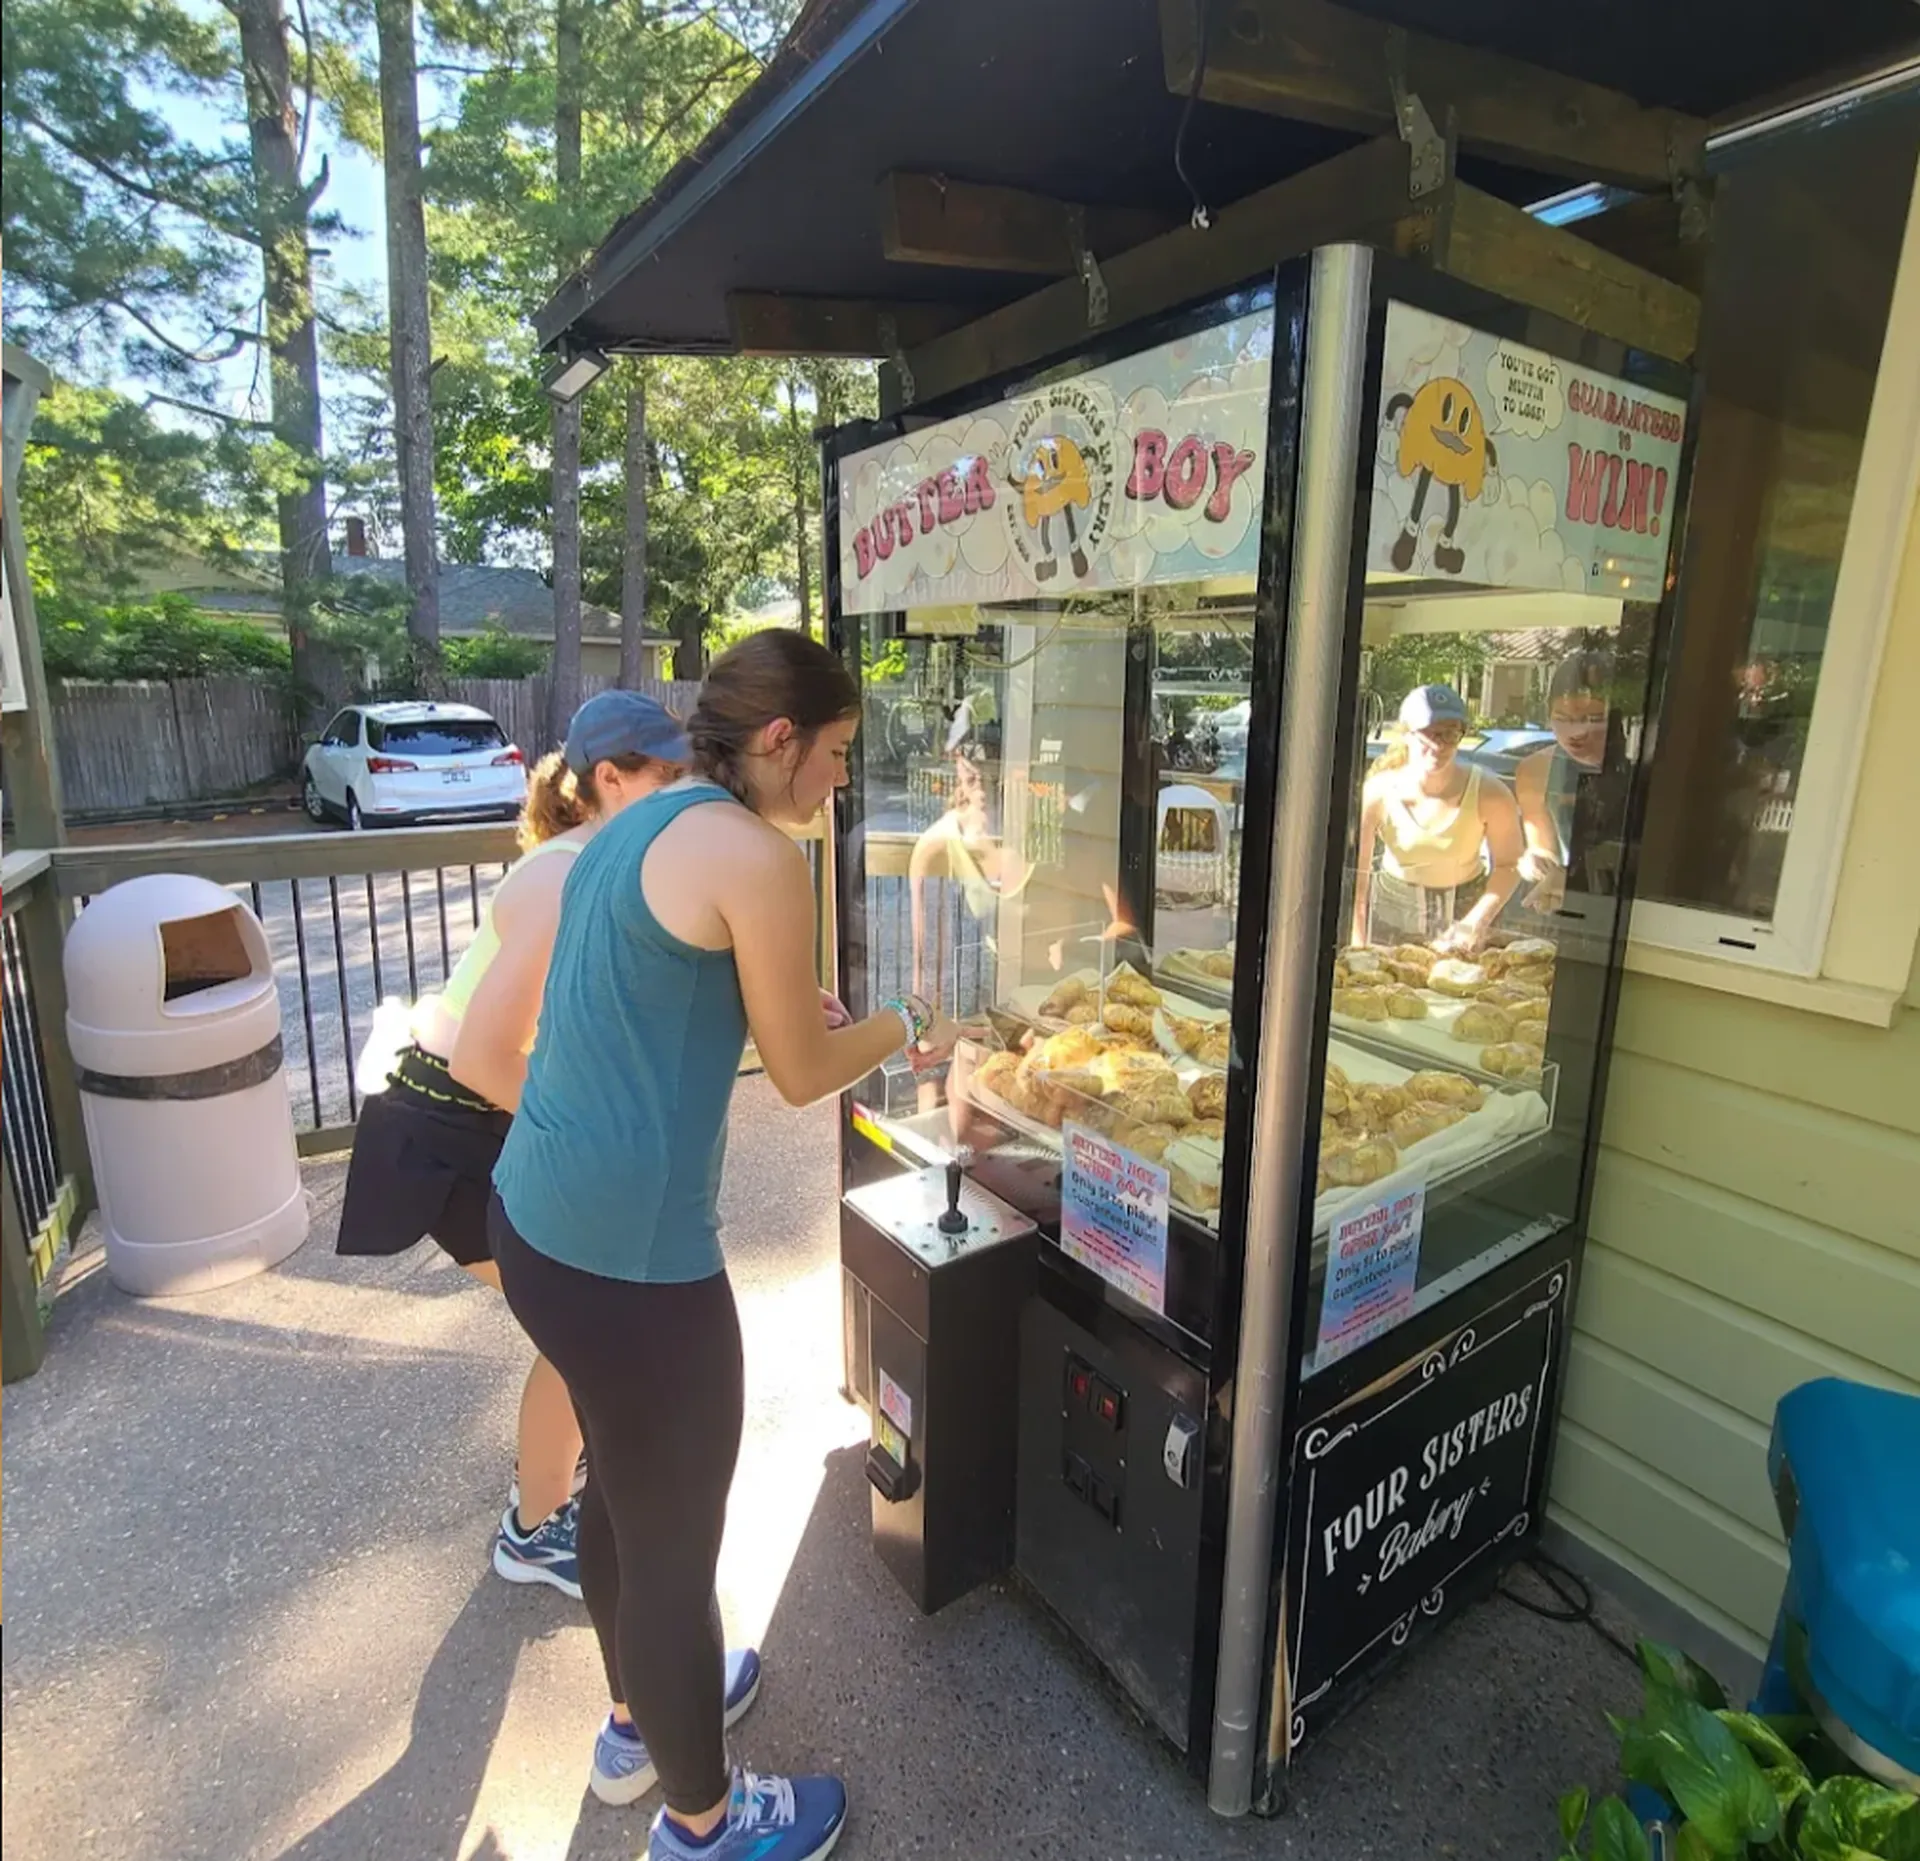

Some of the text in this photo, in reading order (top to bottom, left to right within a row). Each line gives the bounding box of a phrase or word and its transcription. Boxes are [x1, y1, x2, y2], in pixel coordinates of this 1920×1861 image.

[1500, 352, 1556, 385] YOU'VE GOT
[1503, 396, 1546, 423] TO LOSE!
[1567, 378, 1682, 443] GUARANTEED
[853, 427, 1256, 580] BUTTER BOY
[1013, 385, 1113, 550] FOUR SISTERS BAKERY
[1566, 442, 1668, 537] WIN!
[1071, 1171, 1096, 1197] Only
[1126, 1201, 1158, 1229] play!
[1335, 1261, 1361, 1284] Only
[1323, 1384, 1532, 1577] FOUR SISTERS
[1378, 1487, 1476, 1583] Bakery
